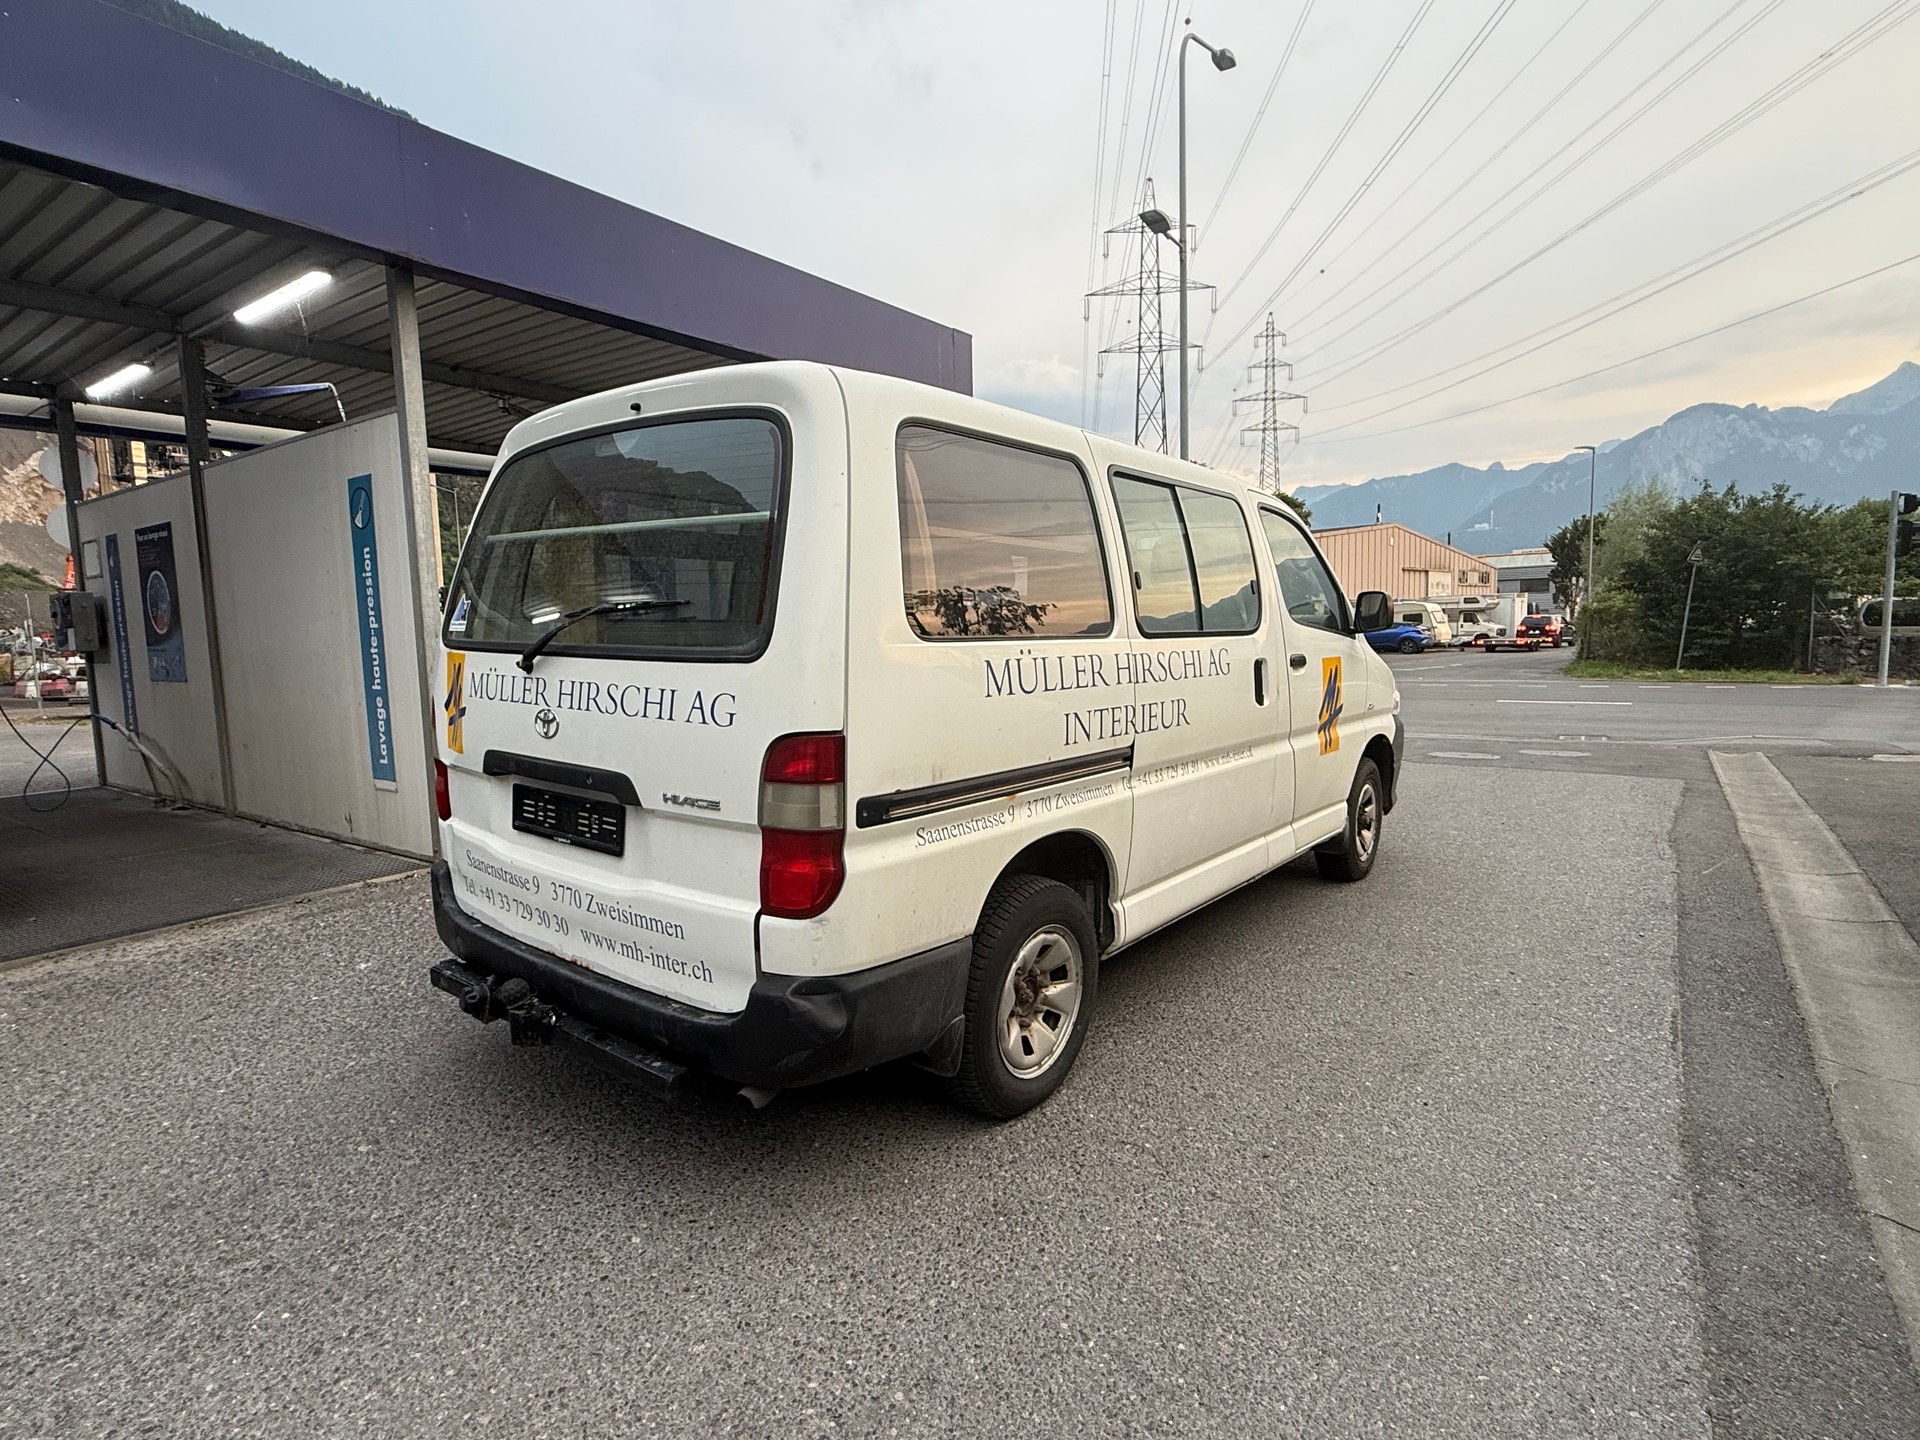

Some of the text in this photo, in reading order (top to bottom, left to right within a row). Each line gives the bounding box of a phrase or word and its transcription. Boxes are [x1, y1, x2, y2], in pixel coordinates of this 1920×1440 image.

[362, 546, 388, 765] Lavage haute-pression
[984, 647, 1231, 698] MÜLLER HIRSCHI AG
[469, 667, 737, 728] MÜLLER HIRSCHI AG
[1063, 698, 1190, 746] INTERIEUR
[662, 792, 721, 811] HIACE
[916, 815, 1006, 847] Saanenstrasse
[1007, 804, 1015, 822] 9
[1027, 795, 1051, 818] 3770
[1054, 783, 1114, 810] Zweisimmen
[1121, 776, 1136, 790] Tel.
[1137, 771, 1152, 786] +41
[1154, 768, 1164, 783] 33
[1166, 763, 1179, 779] 729
[1180, 762, 1189, 776] 30
[1190, 759, 1199, 774] 30
[462, 875, 714, 984] Tel. +41 33 729 30 30 www.mh-inter.ch
[466, 849, 685, 940] Saanenstrasse 9 3770 Zweisimmen
